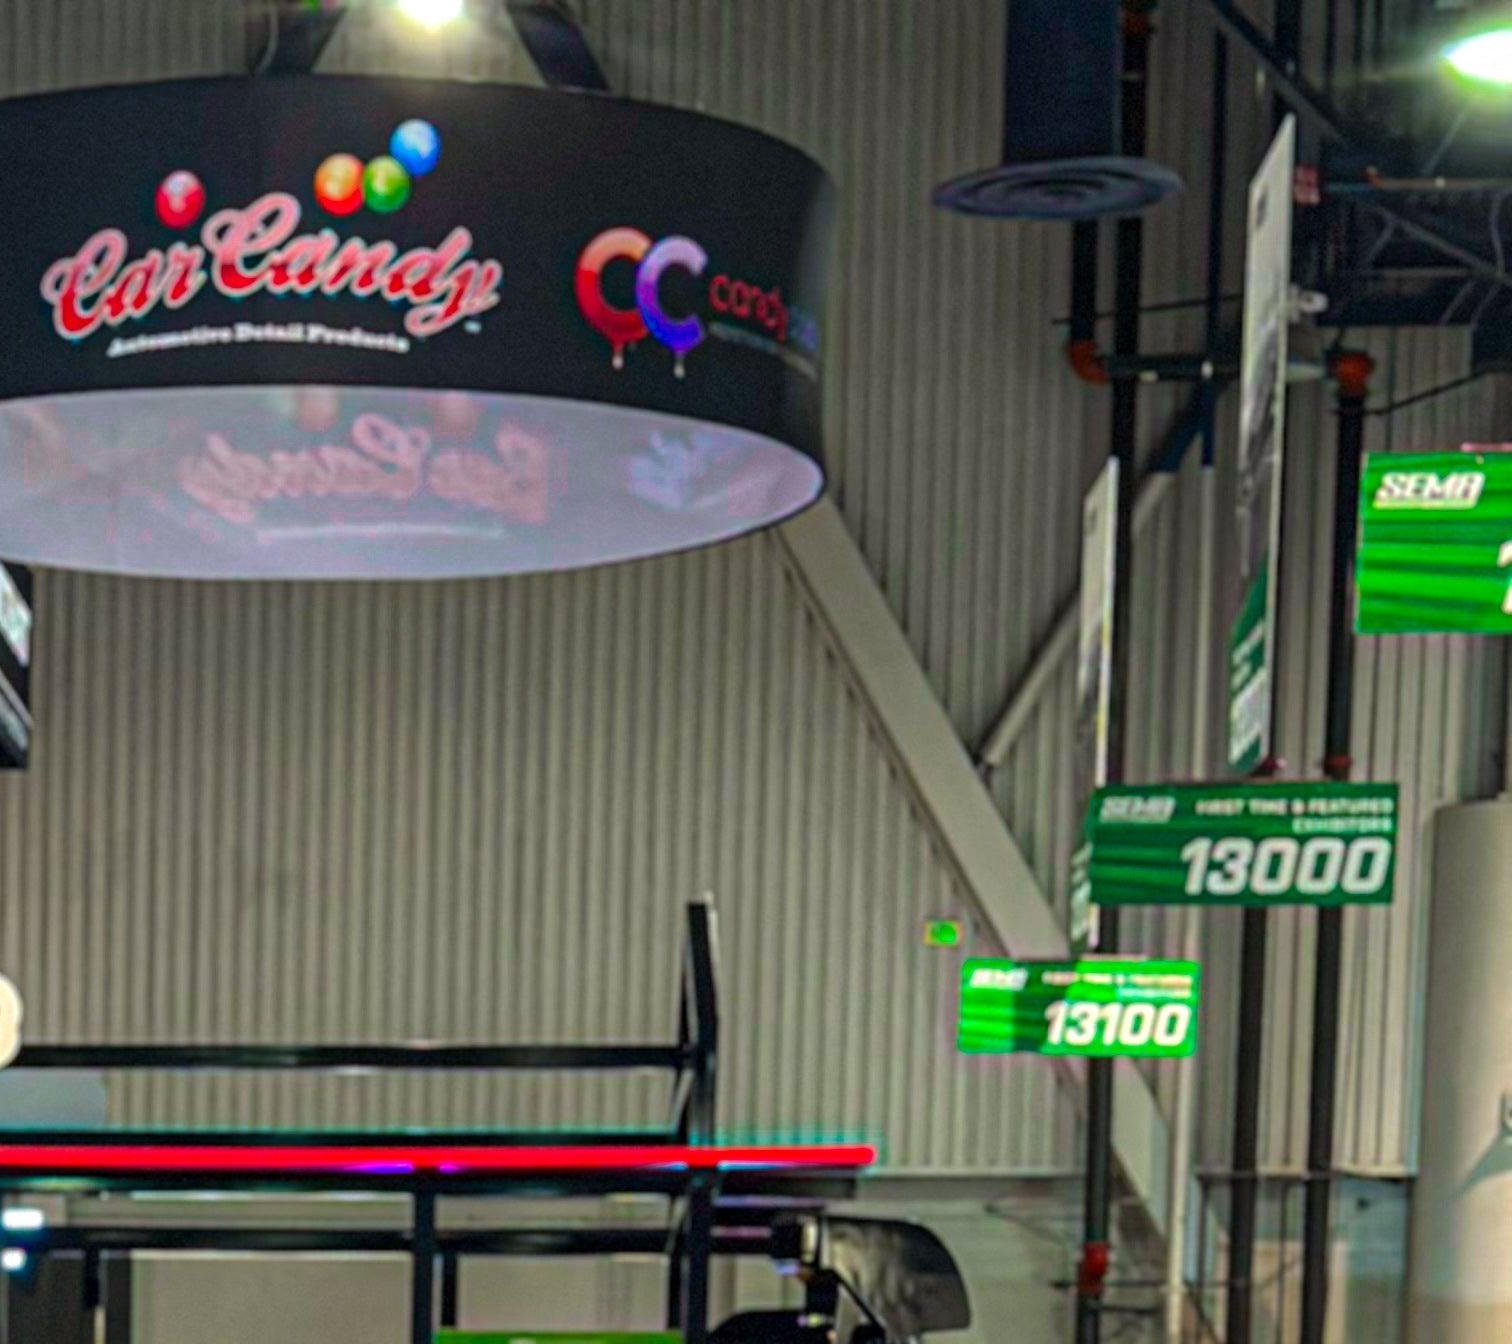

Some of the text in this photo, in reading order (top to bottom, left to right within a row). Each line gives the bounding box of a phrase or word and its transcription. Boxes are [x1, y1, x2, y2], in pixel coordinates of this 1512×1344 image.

[40, 191, 503, 340] Car Candy
[106, 322, 410, 358] Automotive Detail Products
[1180, 836, 1393, 896] 13000
[1044, 1000, 1192, 1047] 13100
